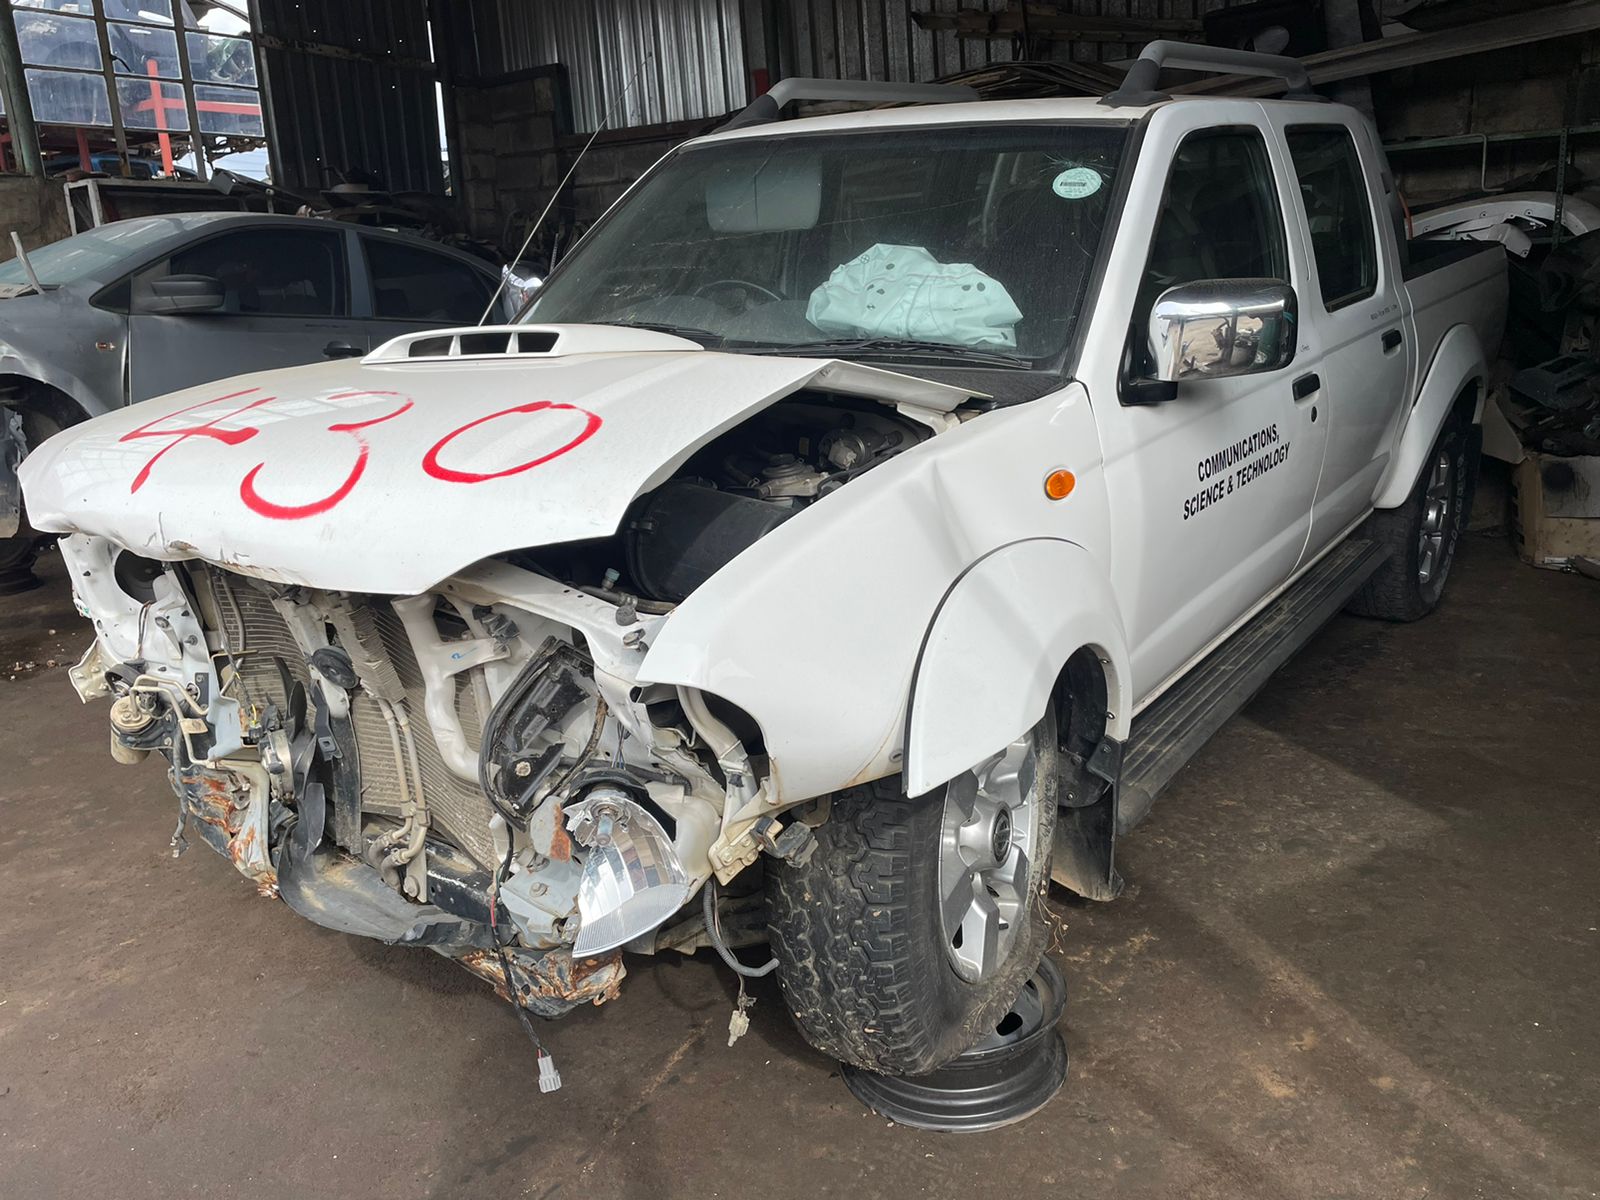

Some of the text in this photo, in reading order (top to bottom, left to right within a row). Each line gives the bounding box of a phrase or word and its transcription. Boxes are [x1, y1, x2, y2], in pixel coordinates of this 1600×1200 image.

[119, 387, 604, 521] 430
[1183, 441, 1291, 520] SCIENCE & TECHNOLOGY
[1197, 423, 1280, 482] COMMUNICATIONS,
